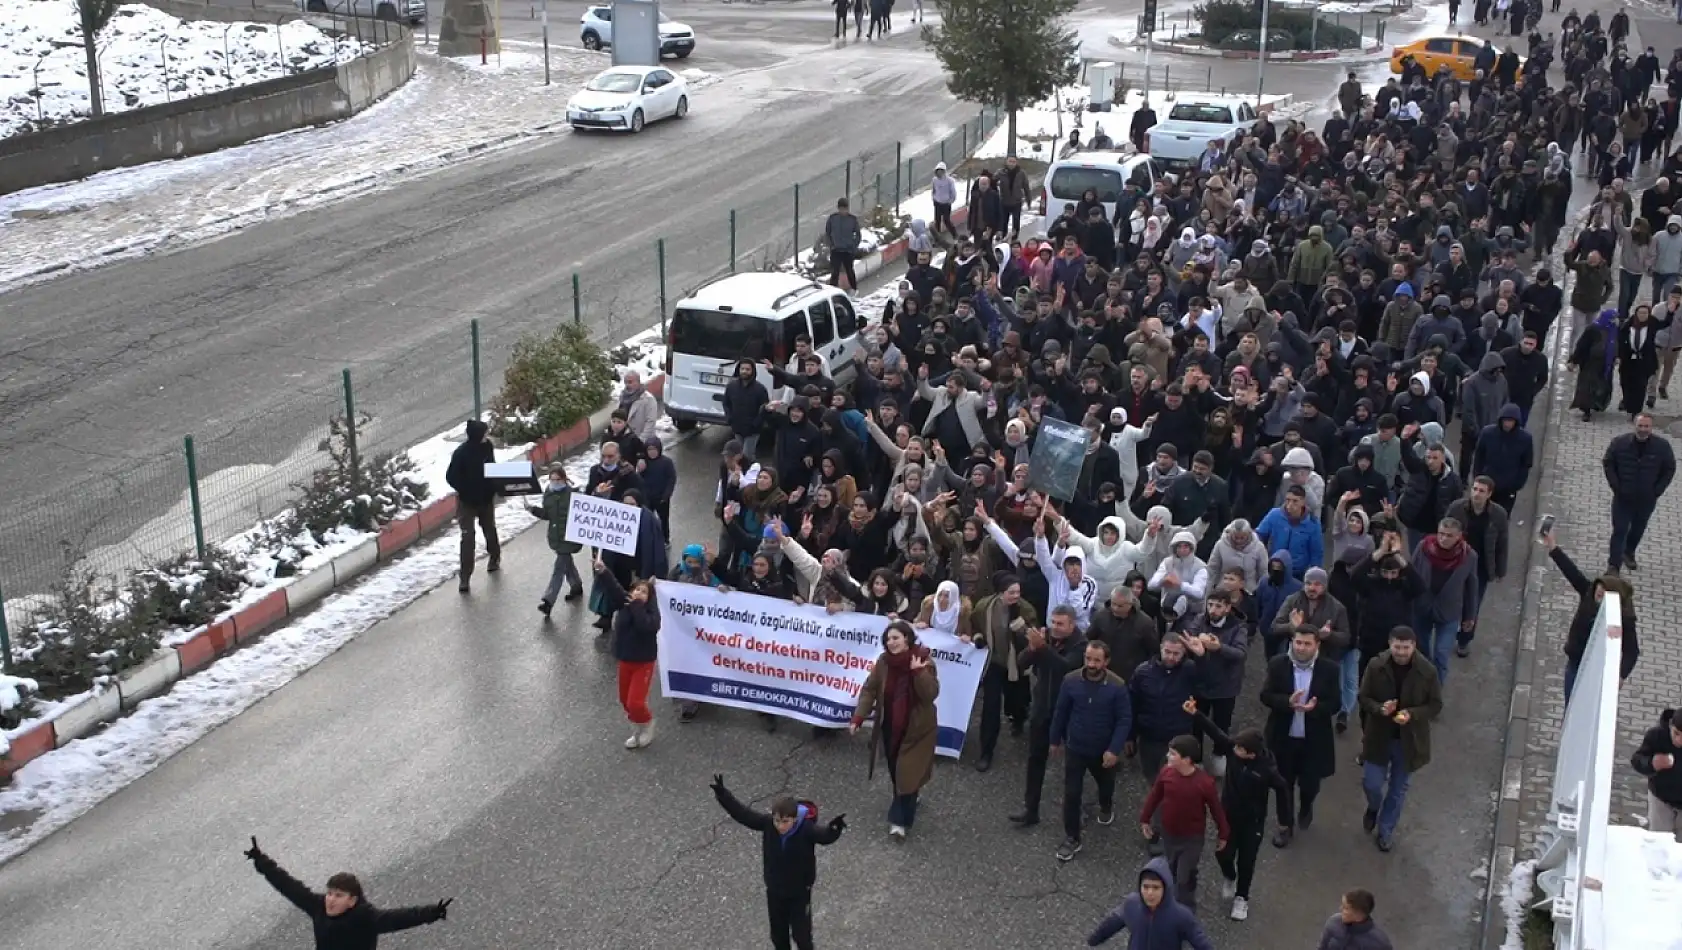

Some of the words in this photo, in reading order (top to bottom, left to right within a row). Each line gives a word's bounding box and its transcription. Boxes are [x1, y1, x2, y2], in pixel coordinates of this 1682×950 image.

[573, 500, 637, 523] ROJAVA'DA
[578, 528, 603, 541] DUR
[669, 598, 704, 616] Rojava
[707, 604, 757, 626] vicdandır,
[930, 648, 972, 667] amaz...
[695, 627, 743, 648] Xwedî
[745, 636, 820, 662] derketina
[712, 653, 786, 678] derketina
[789, 669, 861, 698] mirovahiy
